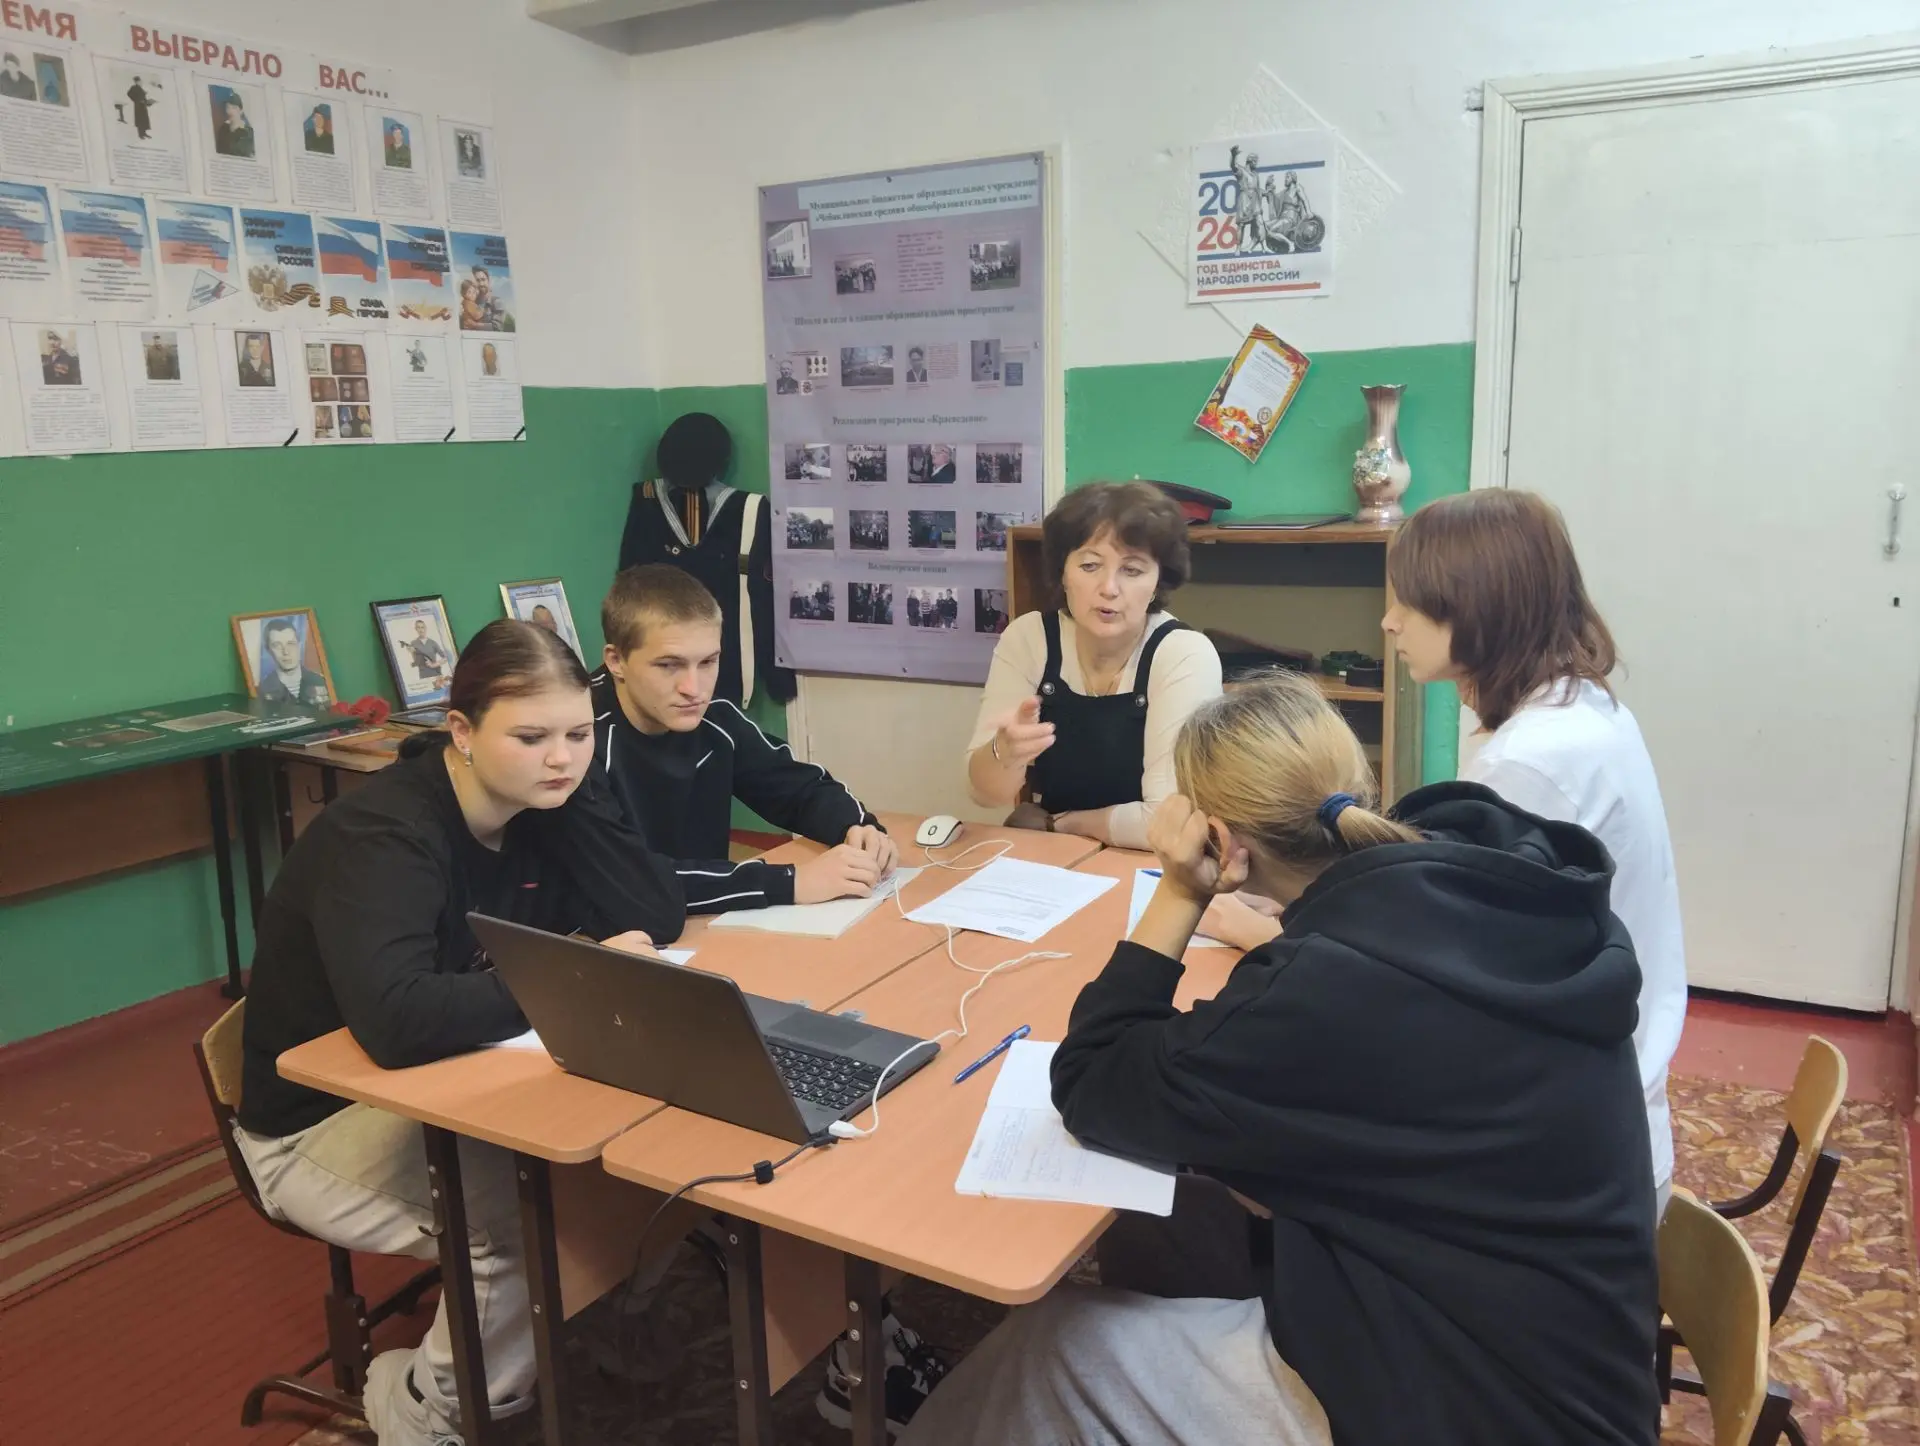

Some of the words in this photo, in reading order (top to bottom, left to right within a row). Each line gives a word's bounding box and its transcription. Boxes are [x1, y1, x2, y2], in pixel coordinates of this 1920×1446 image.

[131, 25, 282, 78] ВЫБРАЛО
[319, 64, 389, 99] ВАС...
[1199, 179, 1241, 216] 20
[1197, 216, 1240, 251] 26
[1197, 264, 1219, 275] ГОД
[1222, 260, 1281, 274] ЕДИНСТВА
[1197, 273, 1250, 286] НАРОДОВ
[1252, 270, 1300, 283] РОССИИ
